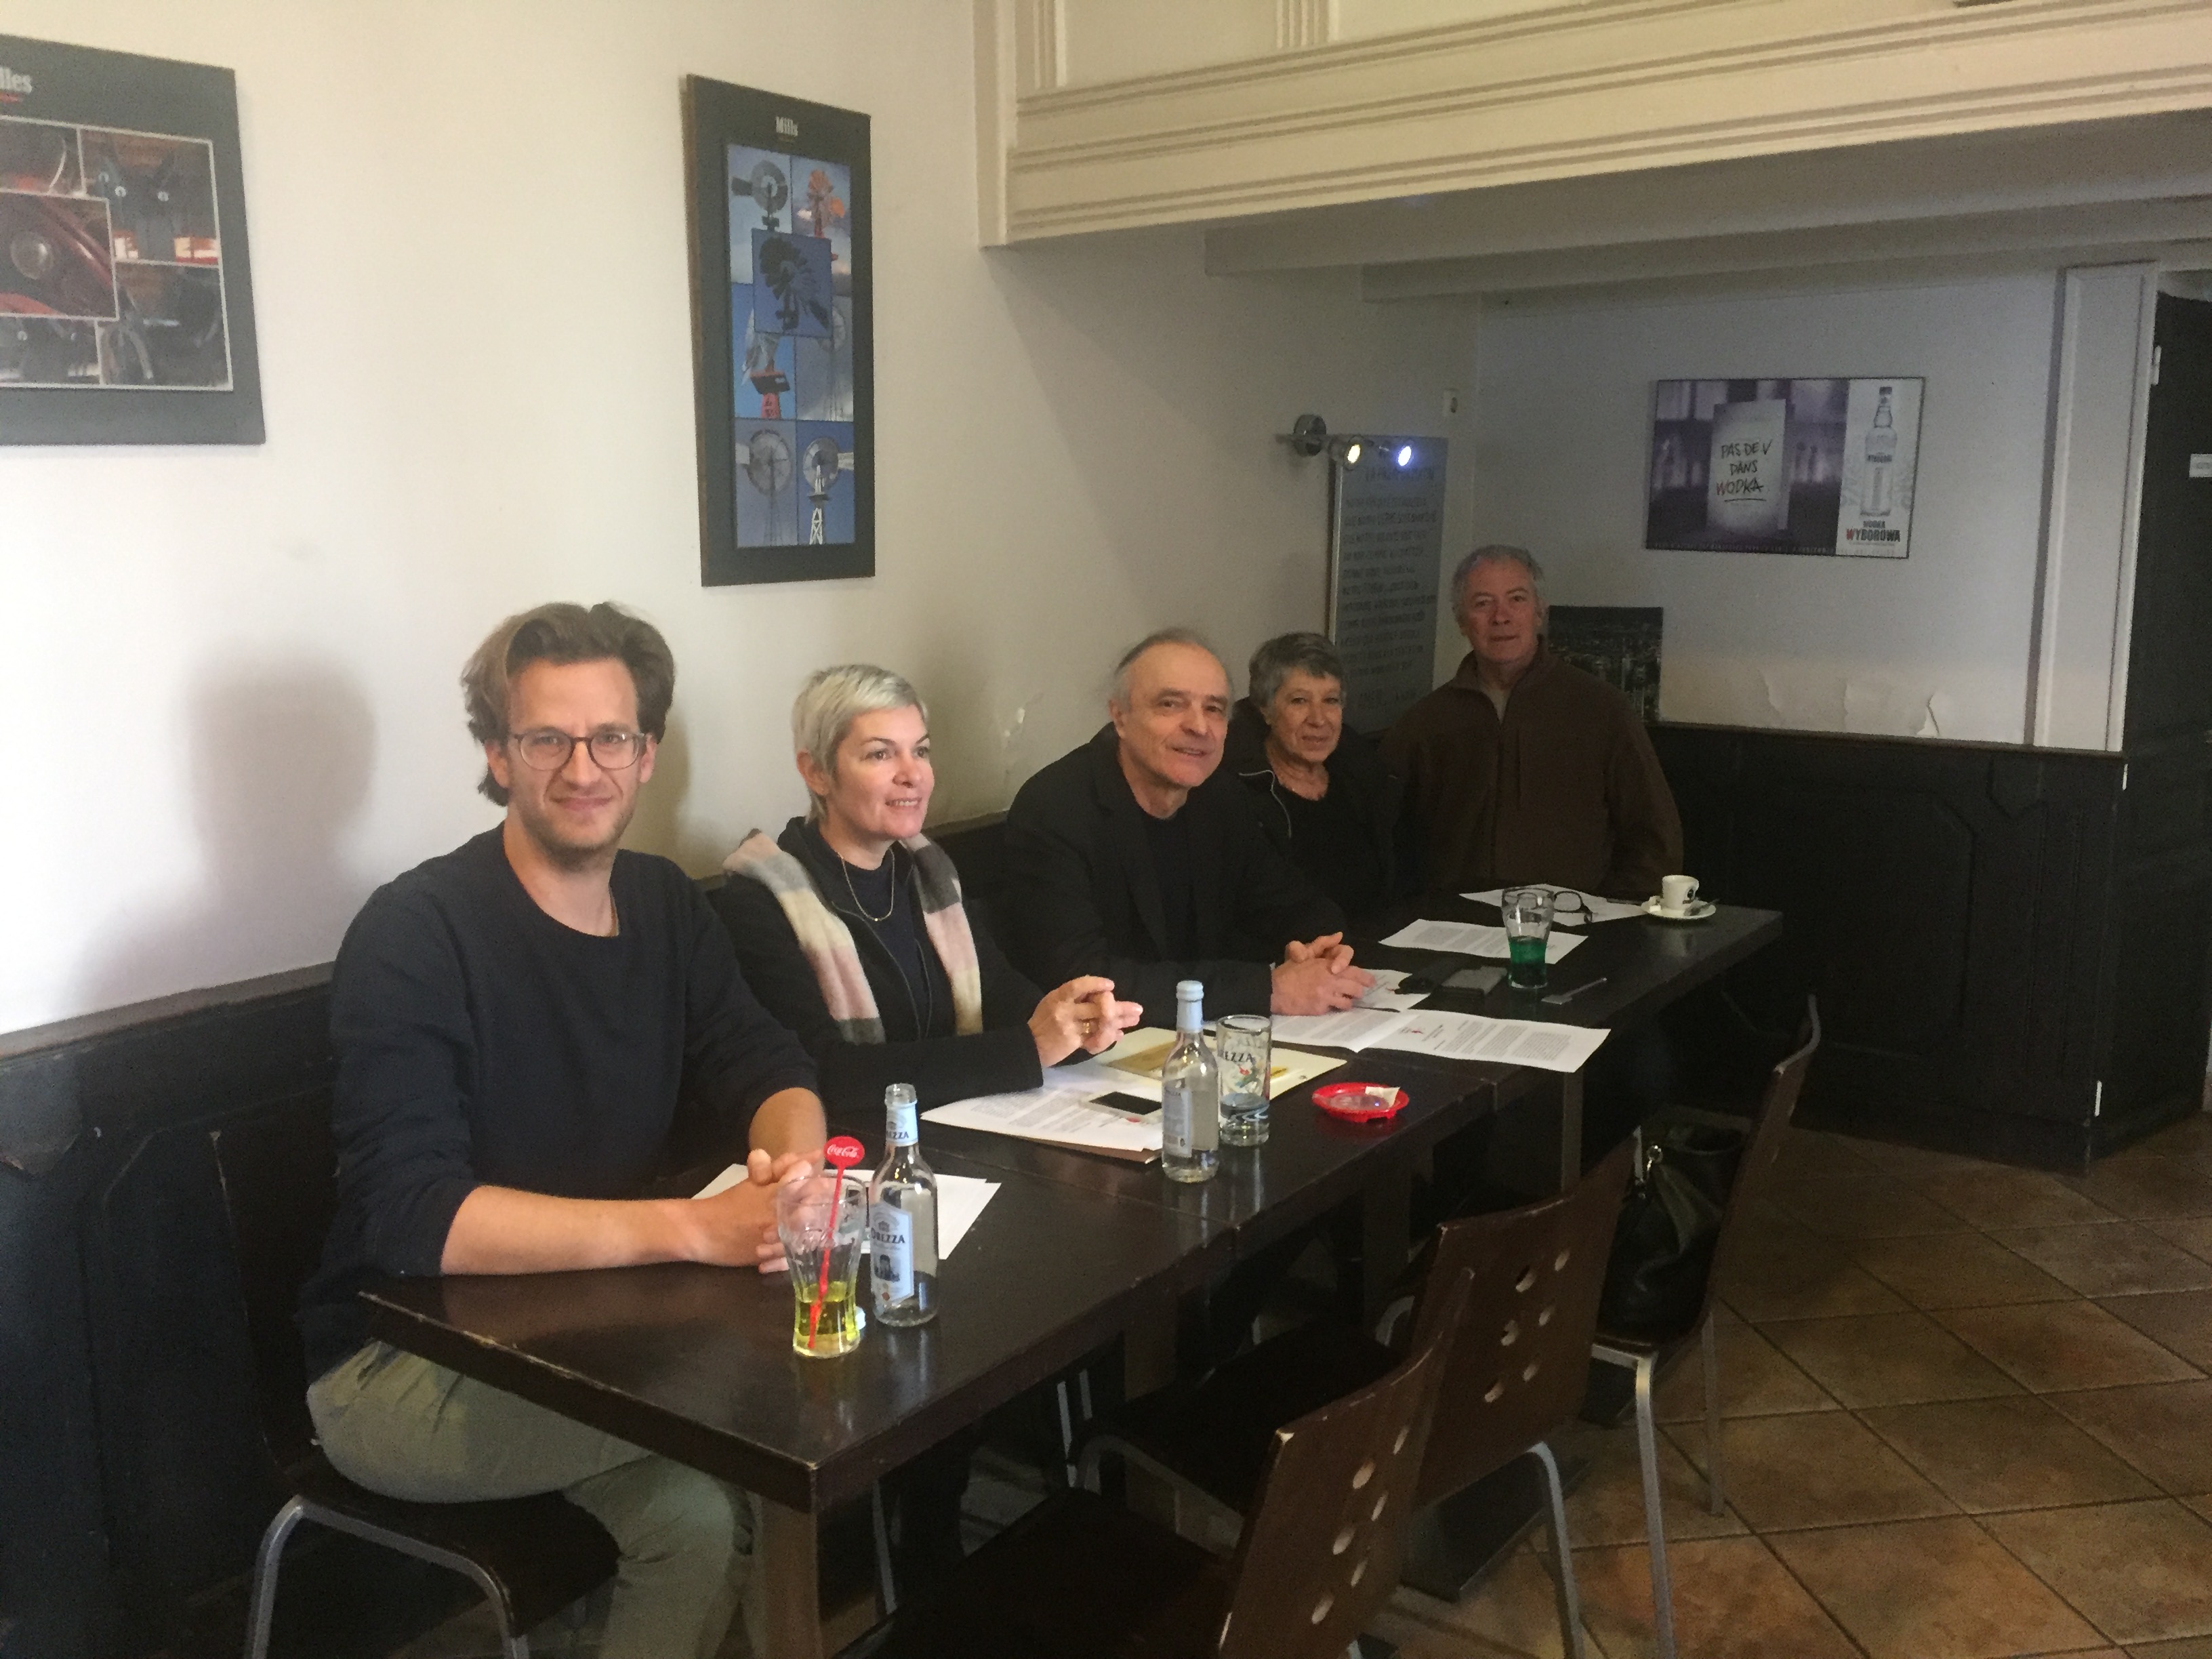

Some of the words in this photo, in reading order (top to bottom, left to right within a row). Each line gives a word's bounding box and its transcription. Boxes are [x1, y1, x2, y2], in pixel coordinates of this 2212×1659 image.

[1721, 443, 1741, 459] PAS
[1744, 441, 1759, 456] DE
[1762, 438, 1773, 455] V
[1729, 459, 1758, 476] DANS
[1716, 476, 1765, 496] WODKA
[1846, 529, 1901, 542] WYBOROWA
